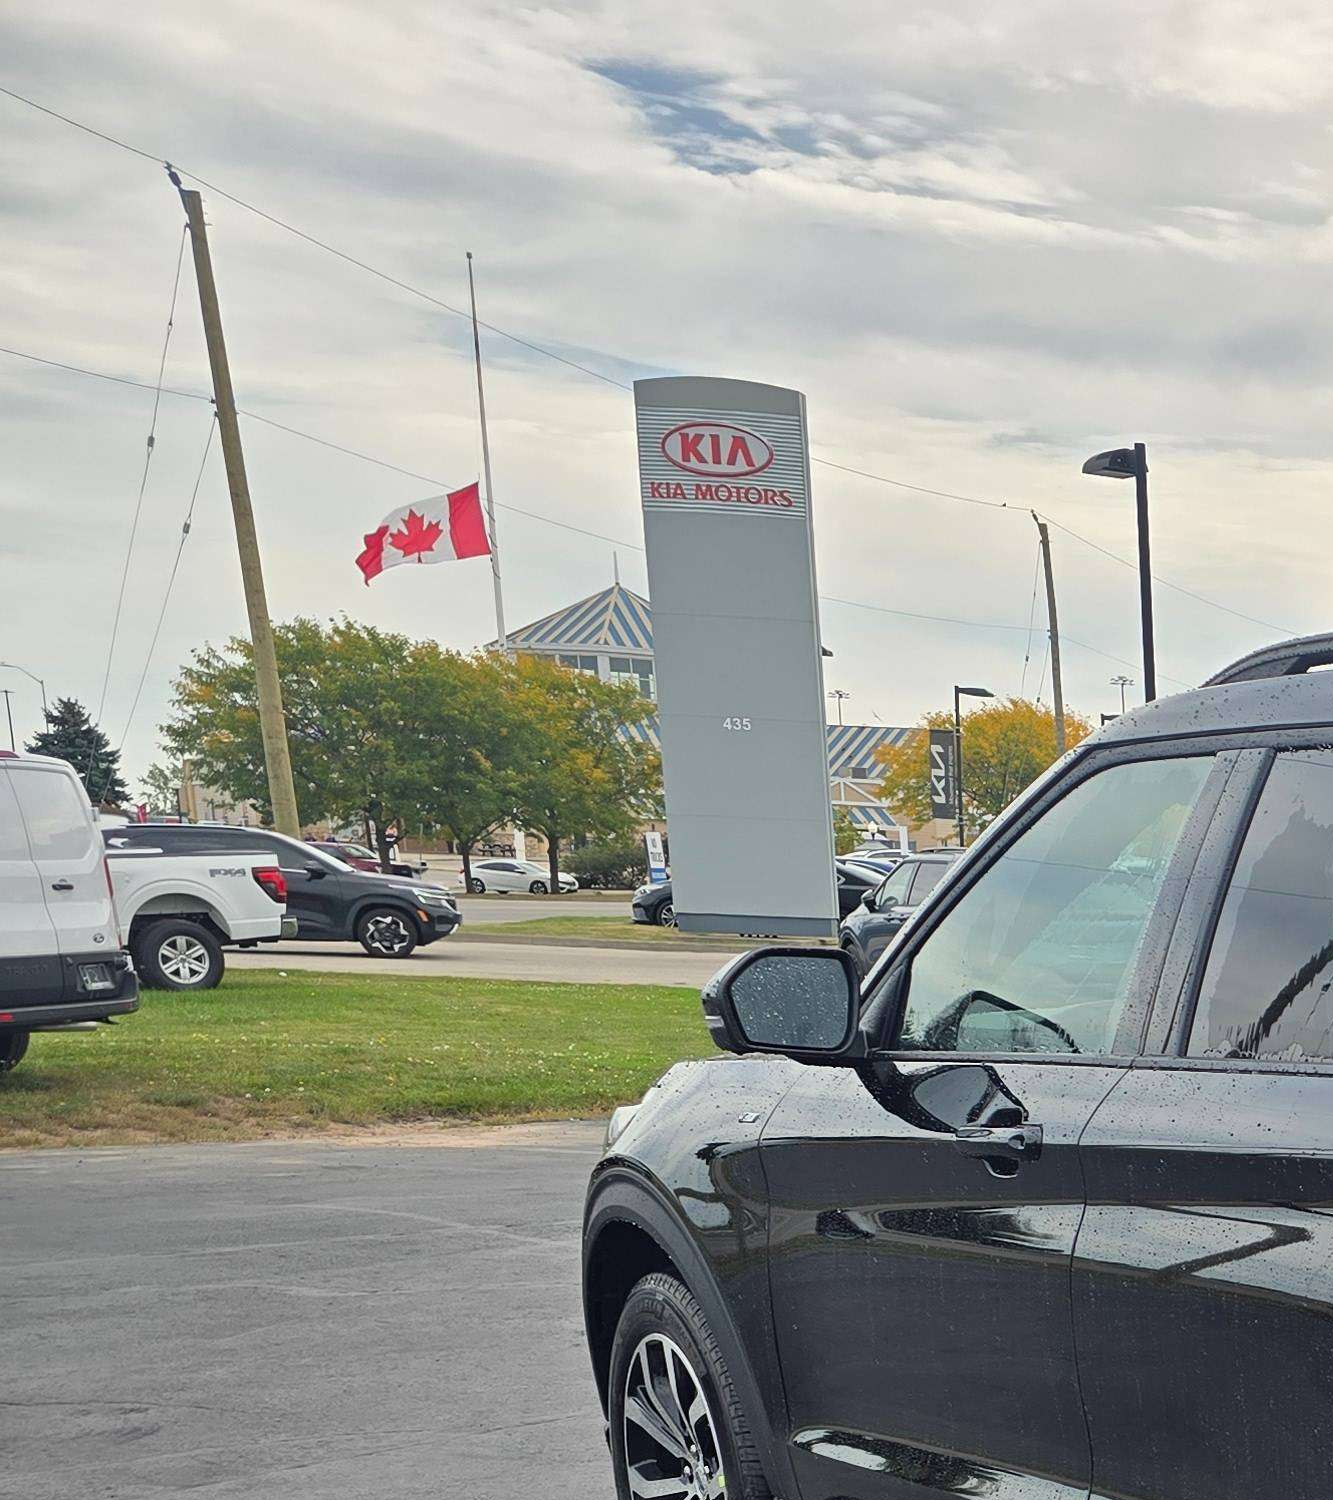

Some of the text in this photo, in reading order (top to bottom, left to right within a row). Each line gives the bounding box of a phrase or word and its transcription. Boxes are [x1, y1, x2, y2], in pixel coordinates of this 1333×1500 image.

[678, 432, 756, 468] KIA
[650, 481, 794, 508] KIA MOTORS
[723, 717, 751, 731] 435
[930, 744, 947, 804] KIA
